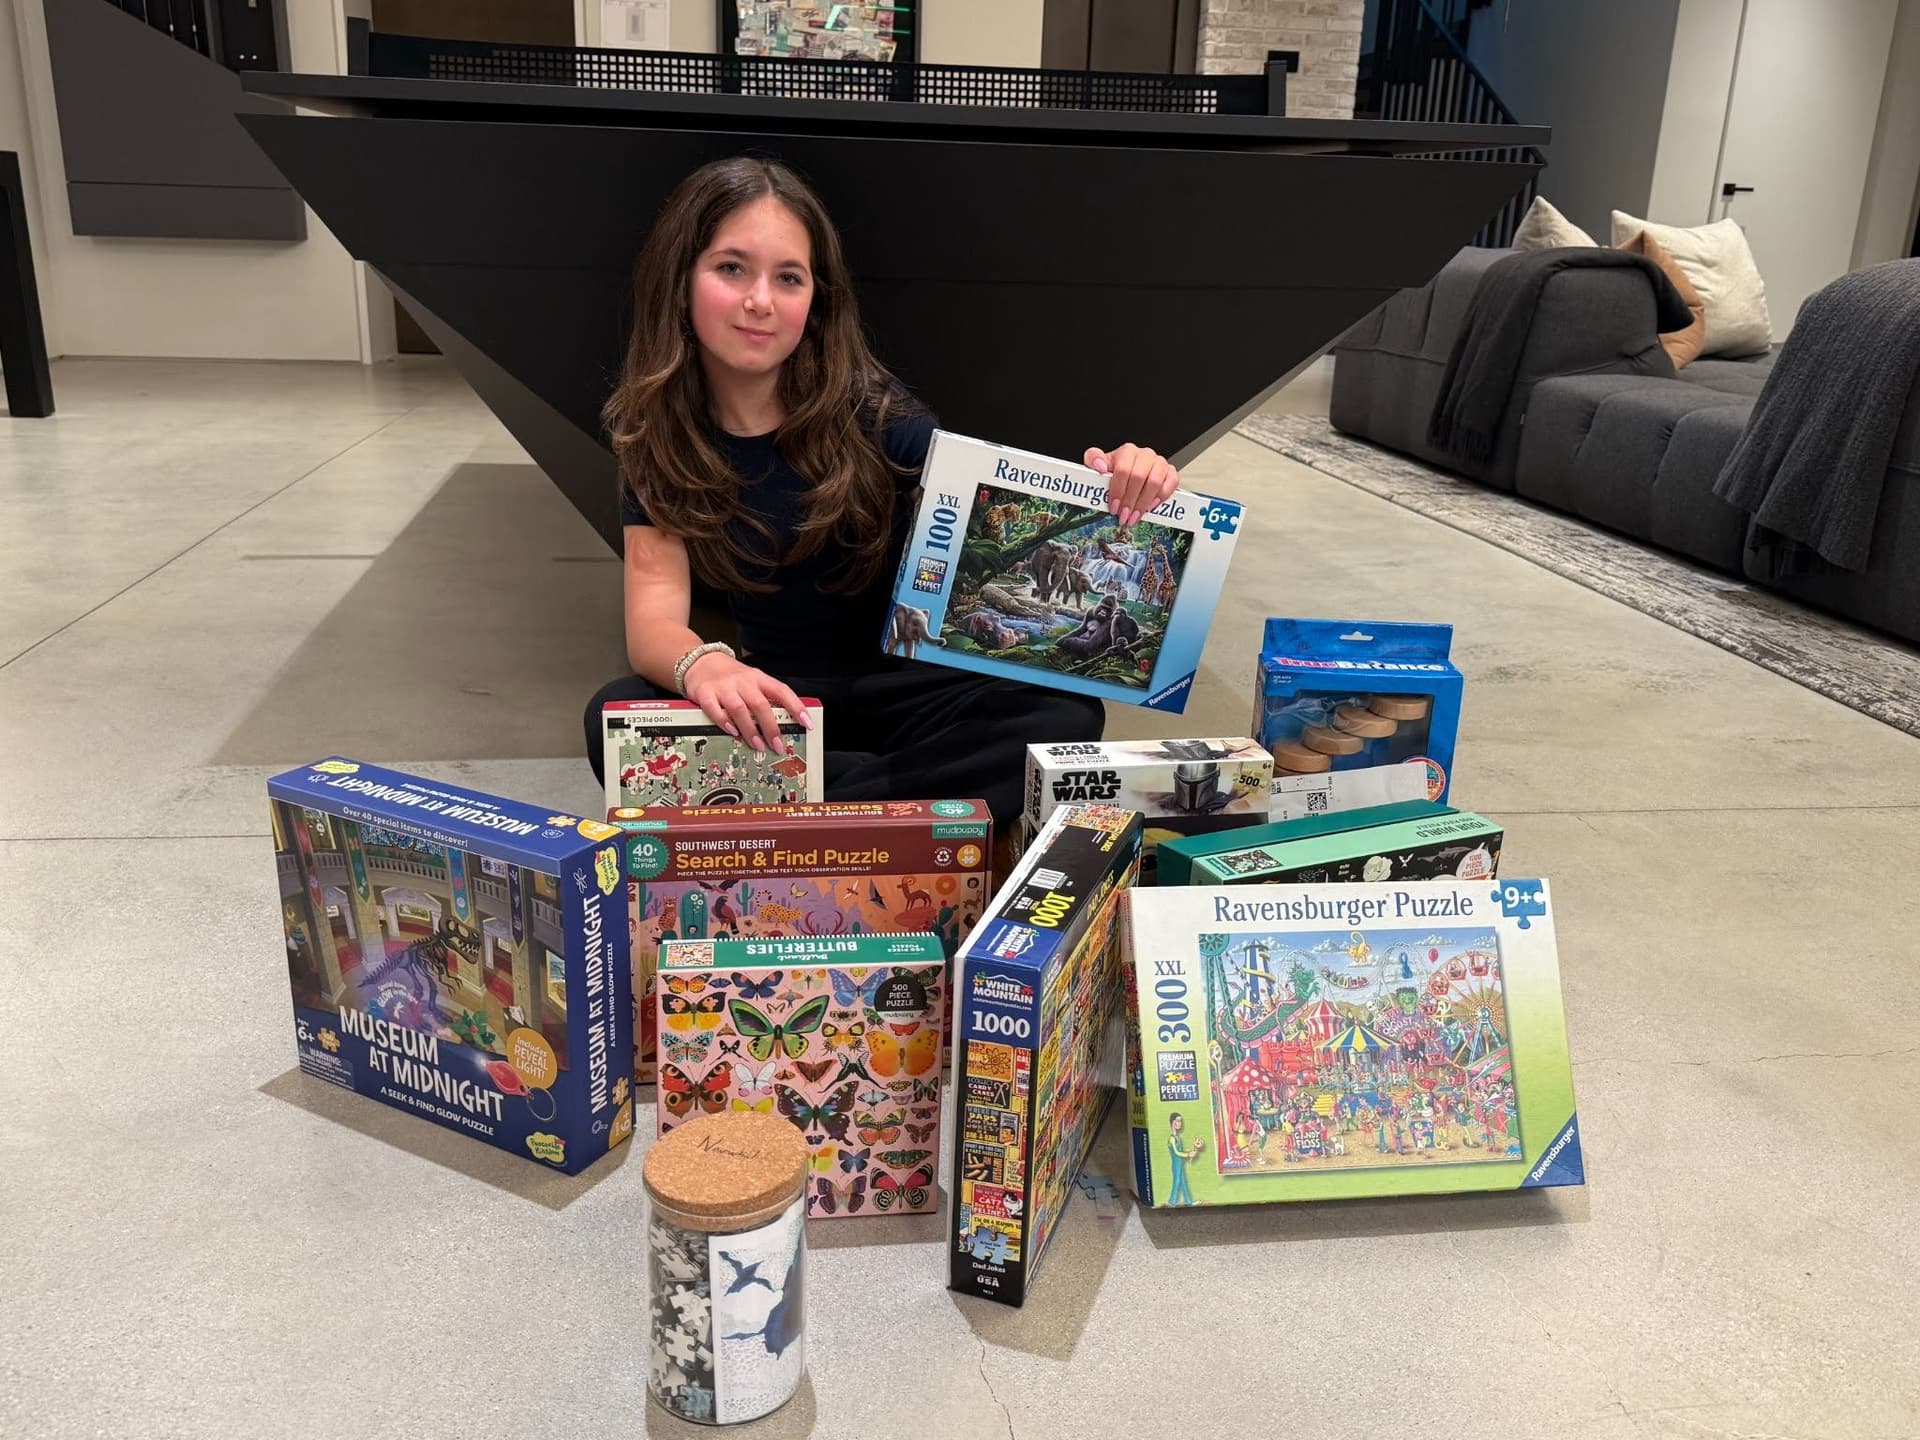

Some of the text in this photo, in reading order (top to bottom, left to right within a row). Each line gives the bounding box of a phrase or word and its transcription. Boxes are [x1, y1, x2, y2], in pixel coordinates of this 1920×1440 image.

[994, 458, 1185, 520] Ravensburge zzle
[937, 492, 961, 509] XXL
[1208, 507, 1228, 523] 6+
[926, 508, 957, 552] 100
[915, 579, 941, 589] PERFECT
[1149, 676, 1192, 706] Ravensburger
[1046, 744, 1101, 752] STAR
[1052, 770, 1121, 786] STAR
[1238, 774, 1260, 787] 500
[1052, 785, 1121, 801] WARS
[326, 776, 539, 836] MUSEUM AT MIDNIGHT
[682, 807, 746, 816] Puzzle
[752, 806, 795, 815] Find
[343, 807, 468, 847] Over 40 special items to discover!
[937, 825, 984, 836] mudpuppy
[1416, 821, 1488, 838] YOUR WORLD
[632, 844, 658, 857] 40+
[675, 839, 777, 851] SOUTHWEST DESERT
[634, 857, 656, 865] Things
[641, 861, 658, 869] Find!
[676, 848, 889, 869] Search & Find Puzzle
[1505, 889, 1532, 909] 9+
[1029, 891, 1076, 928] 1000
[1213, 891, 1473, 926] Ravensburger Puzzle
[746, 941, 858, 954] BUTTERFLIES
[1154, 960, 1186, 976] XXL
[985, 980, 1020, 993] WHITE
[886, 999, 915, 1007] PUZZLE
[973, 986, 1033, 1005] MOUNTAIN
[583, 894, 607, 1114] MUSEUM AT MIDNIGHT
[1155, 979, 1191, 1043] 300
[972, 1011, 1030, 1038] 1000
[298, 1026, 315, 1042] 6+
[340, 1005, 439, 1066] MUSEUM
[516, 1036, 548, 1058] Includes
[514, 1044, 548, 1070] REVEAL
[1159, 1052, 1194, 1060] PREMIUM
[515, 1060, 545, 1080] LIGHT!
[1160, 1060, 1195, 1070] PUZZLE
[370, 1046, 389, 1073] AT
[393, 1056, 504, 1121] MIDNIGHT
[1161, 1084, 1196, 1093] PERFECT
[380, 1086, 494, 1135] A SEEK & FIND GLOW PUZZLE
[1531, 1126, 1575, 1181] Ravensburger
[972, 1262, 1006, 1273] Dad Jokes
[977, 1276, 1000, 1287] USA
